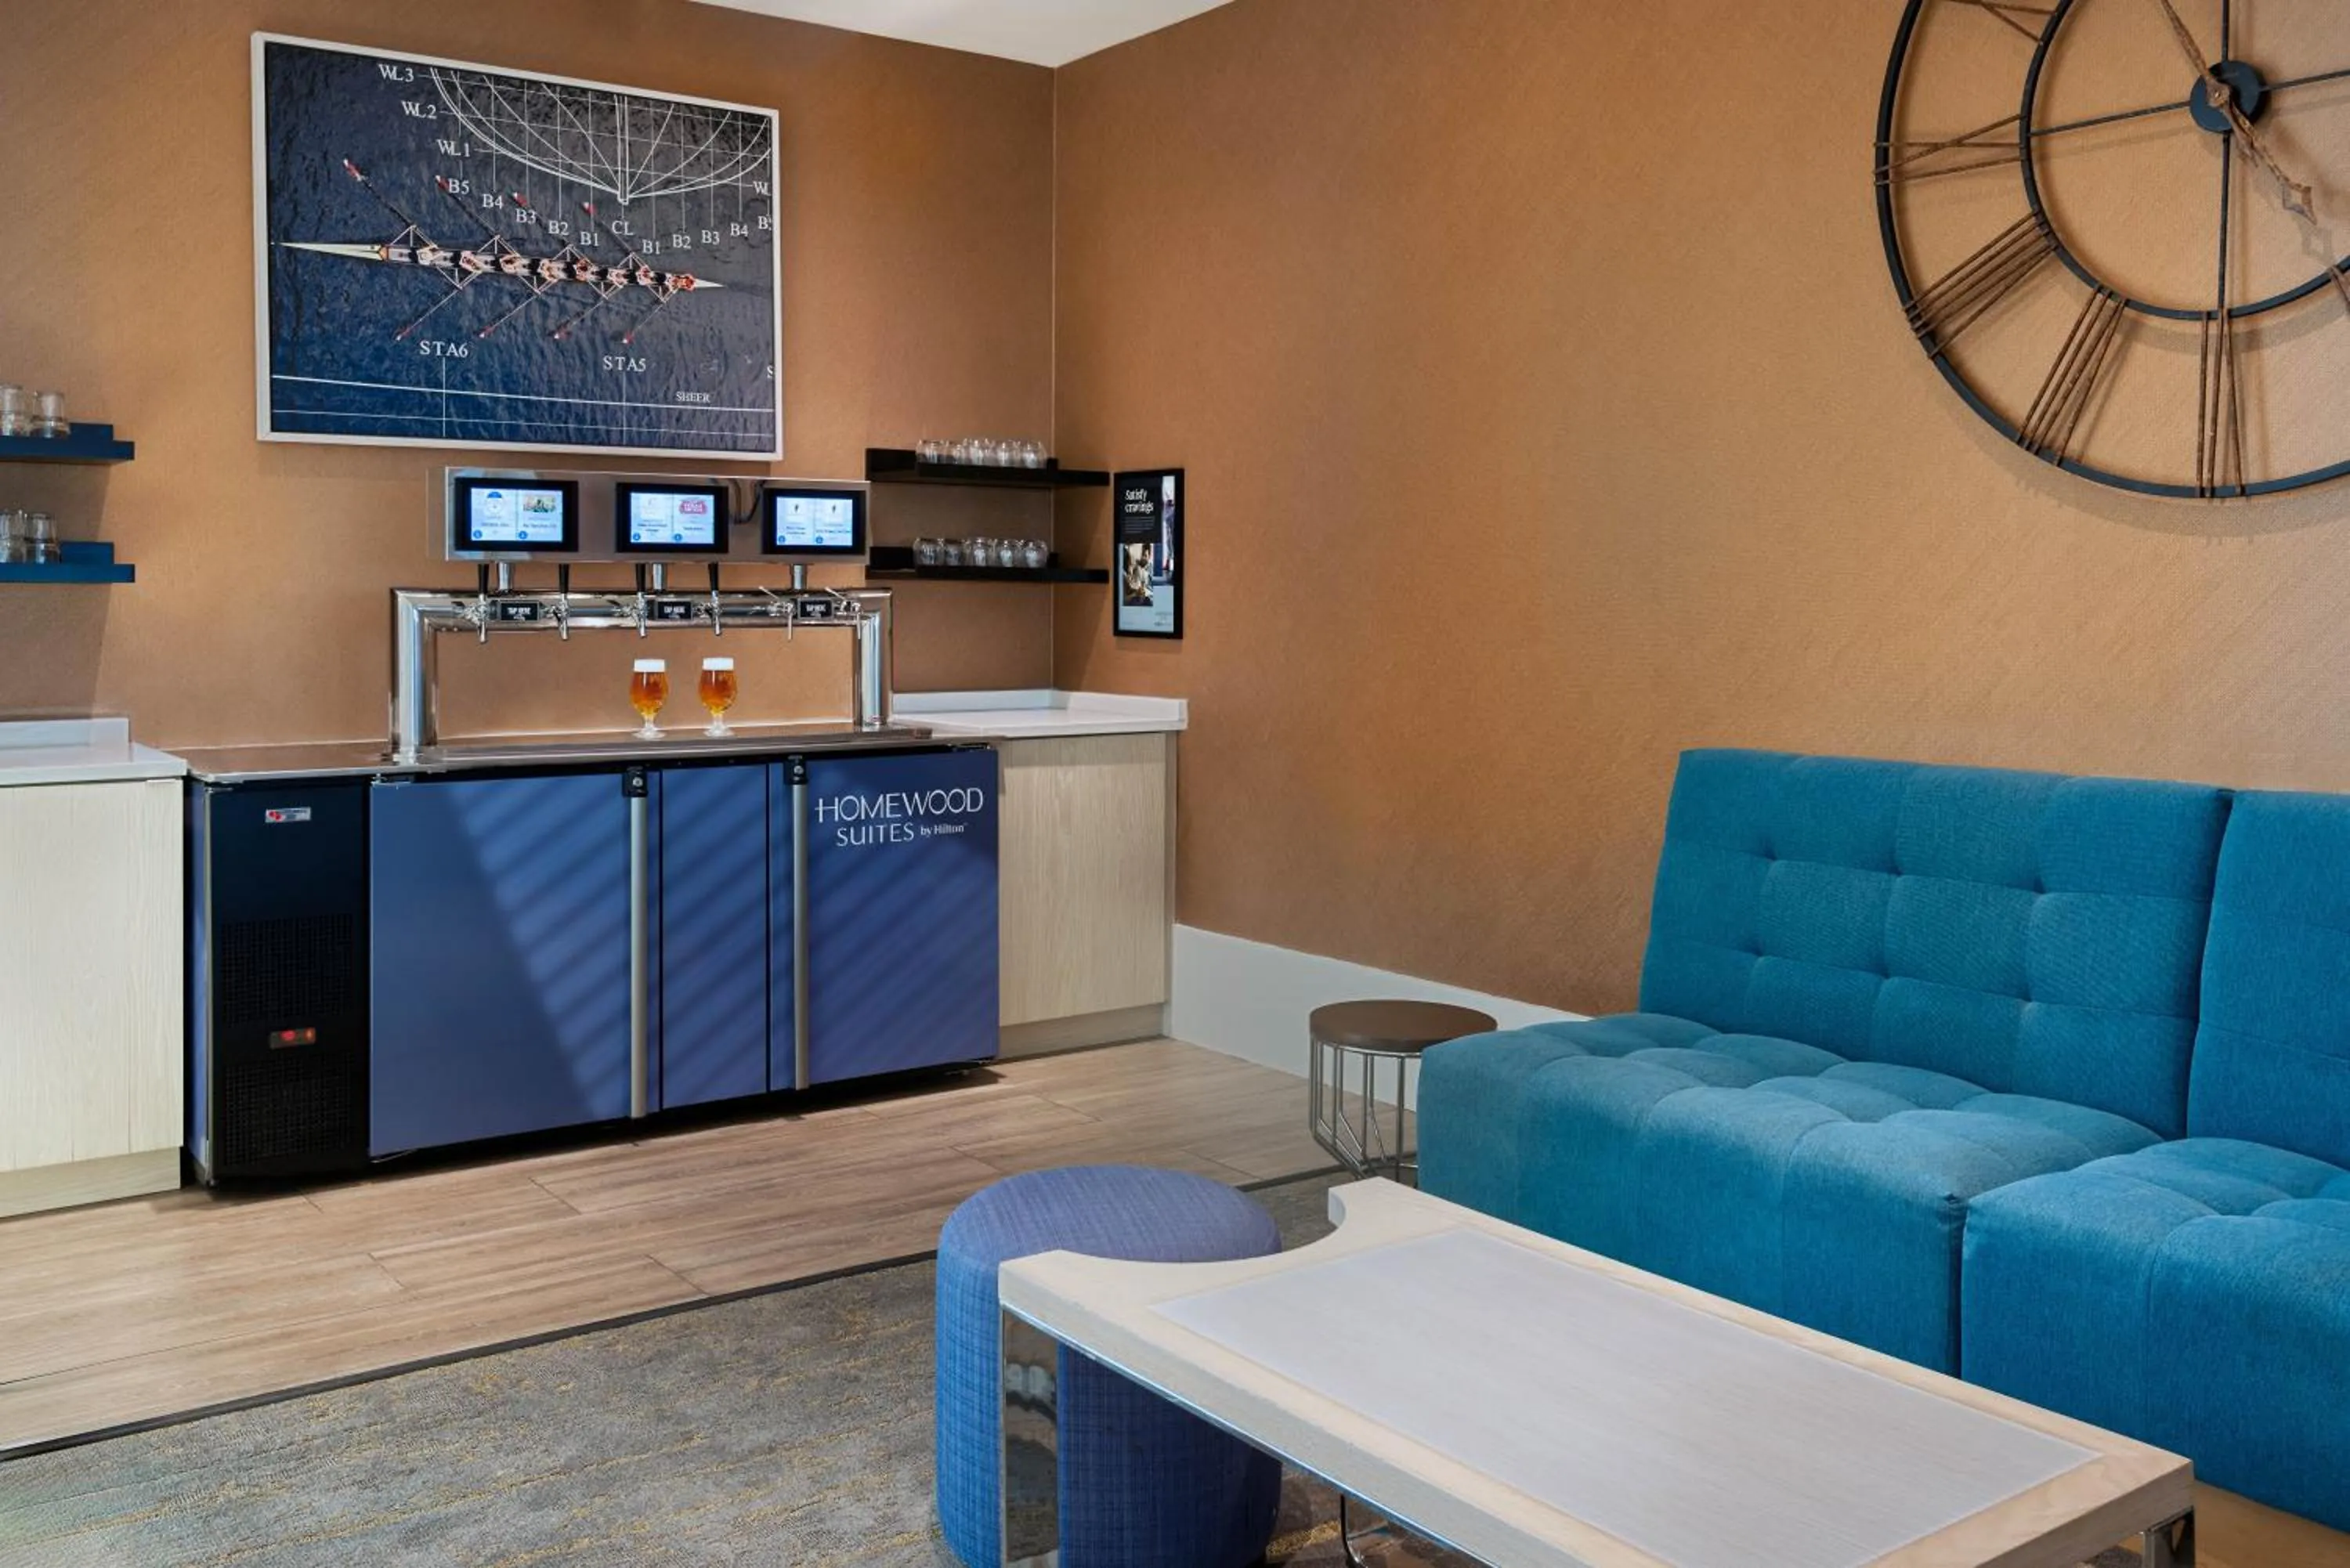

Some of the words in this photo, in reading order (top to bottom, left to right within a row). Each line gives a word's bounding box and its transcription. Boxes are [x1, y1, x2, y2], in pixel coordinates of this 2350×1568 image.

[449, 179, 469, 195] B5
[483, 193, 504, 209] B4
[515, 208, 537, 224] B3
[548, 220, 569, 236] B2
[612, 221, 633, 236] CL
[730, 222, 749, 237] B4
[580, 232, 600, 247] B1
[672, 234, 692, 250] B2
[701, 229, 720, 245] B3
[642, 239, 661, 255] B1
[815, 787, 984, 823] HOMEWOOD
[836, 822, 915, 847] SUITES
[920, 824, 933, 838] by
[934, 822, 964, 835] Hilton
